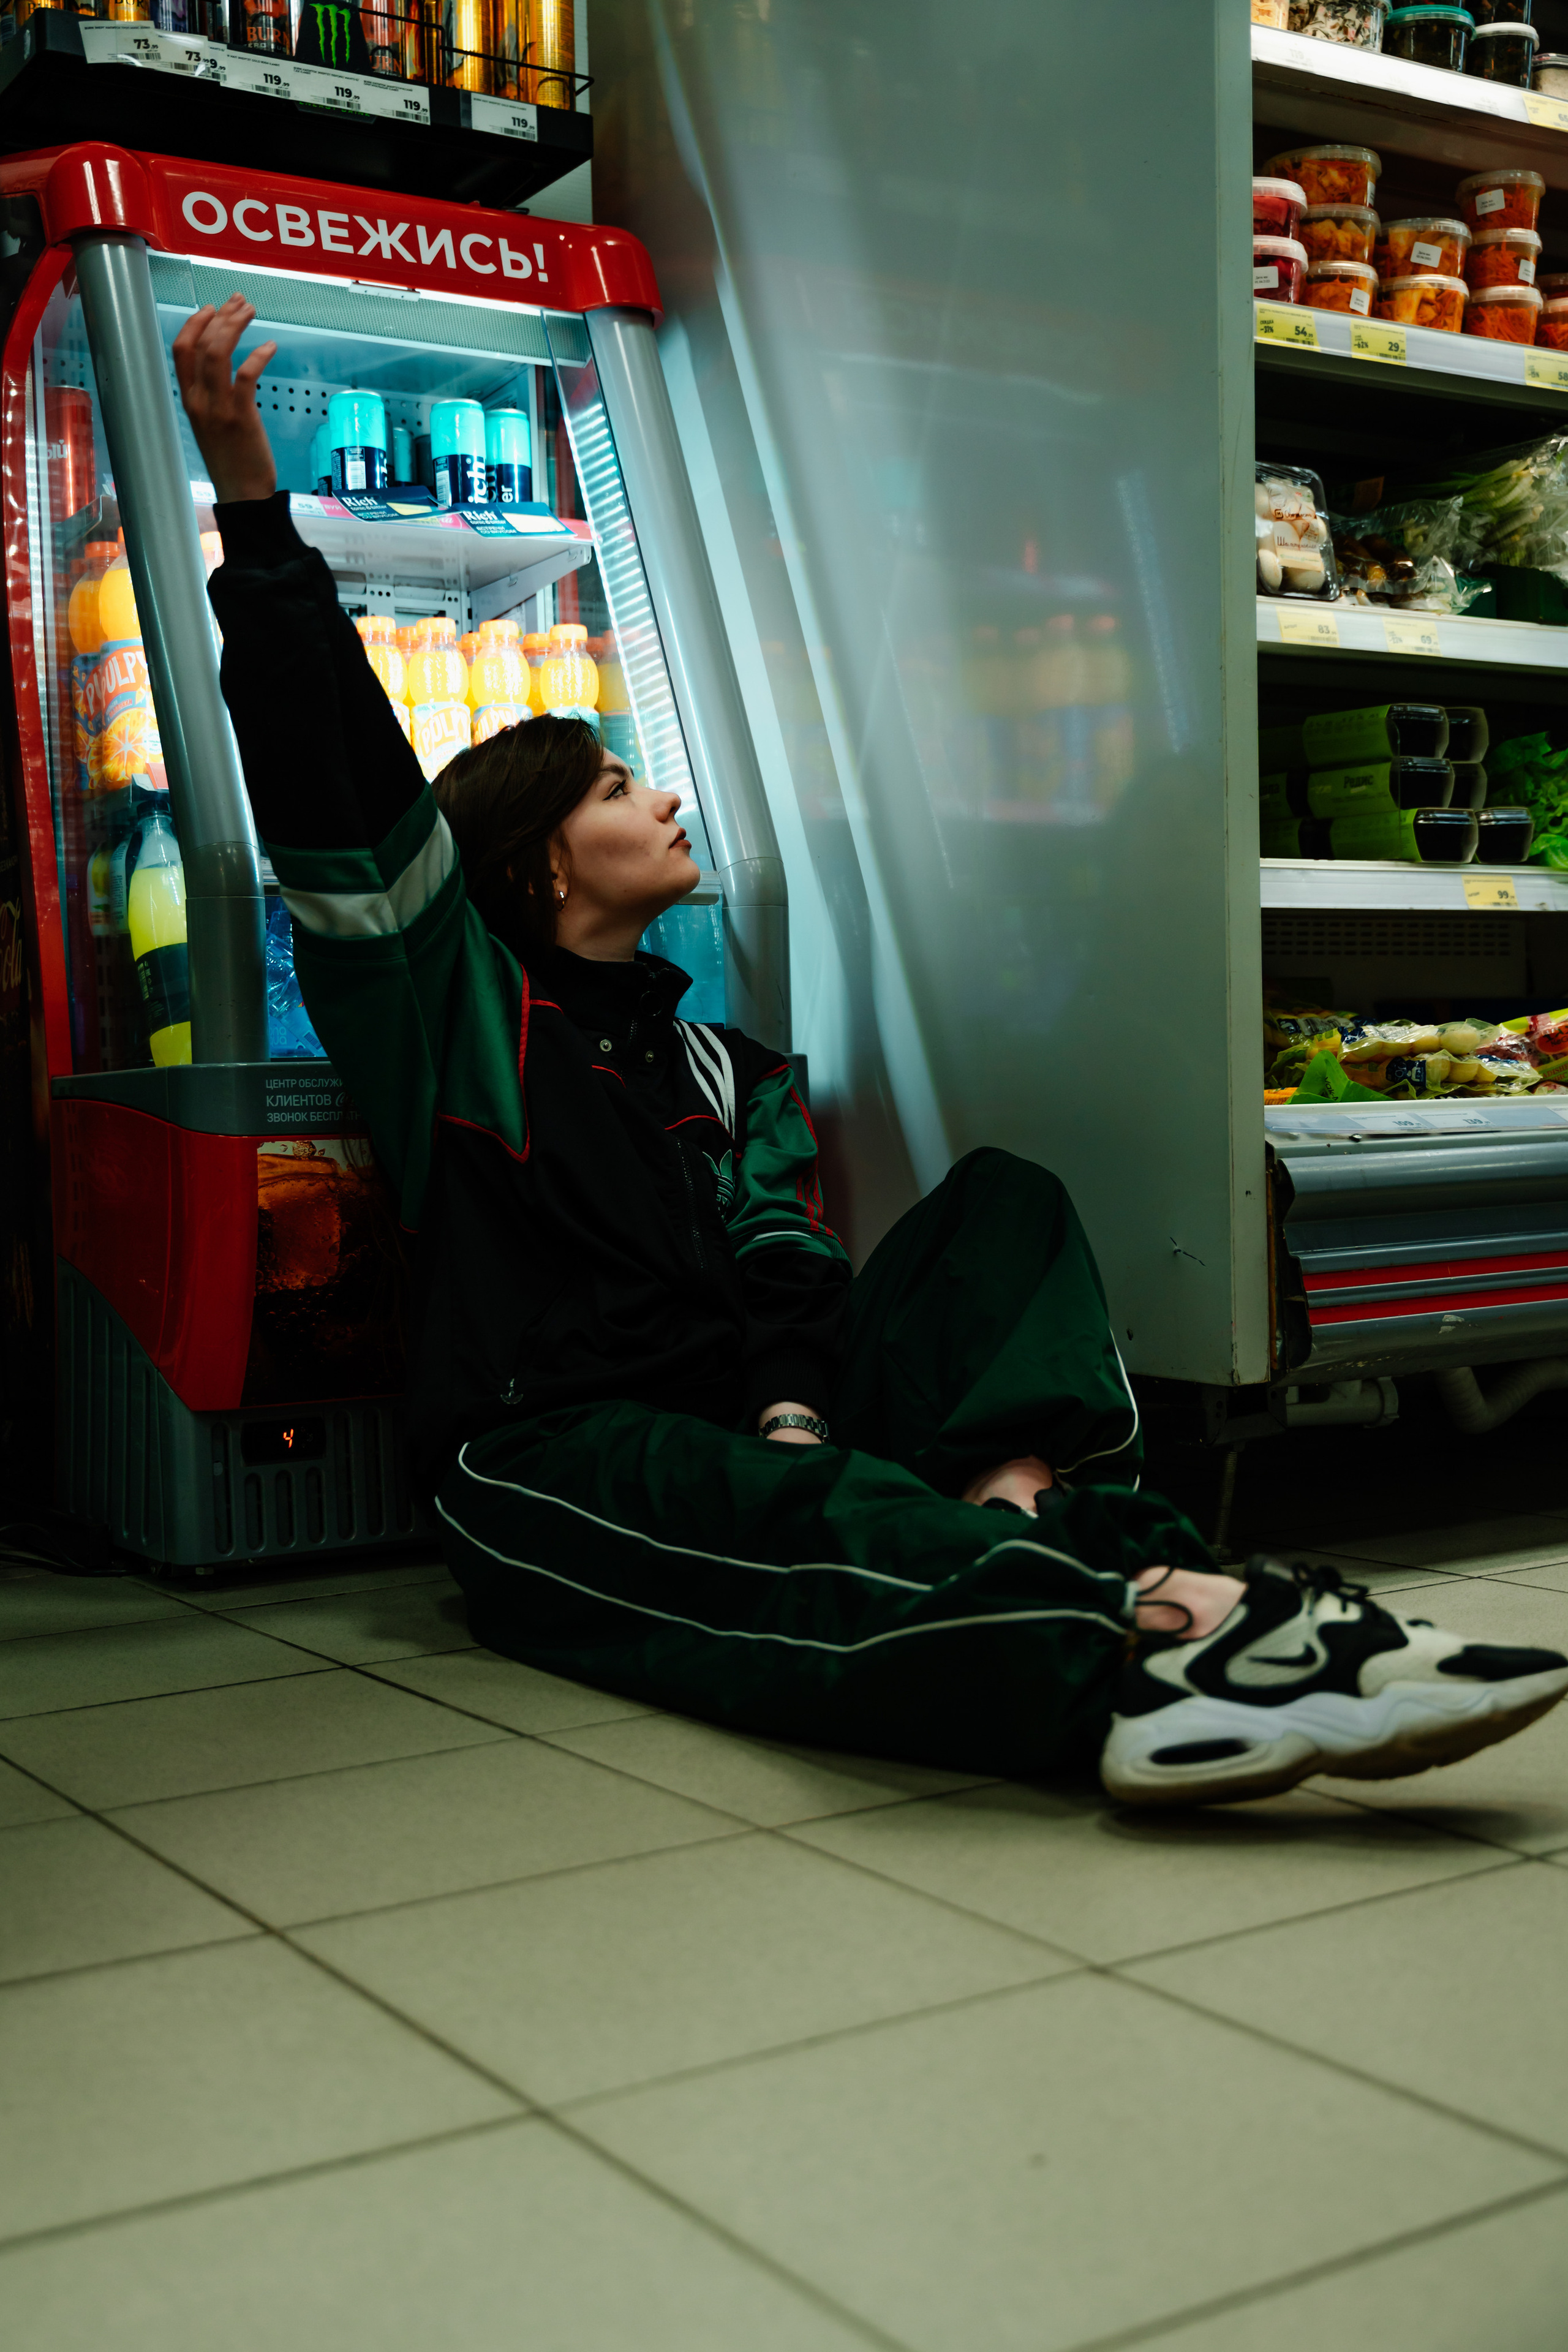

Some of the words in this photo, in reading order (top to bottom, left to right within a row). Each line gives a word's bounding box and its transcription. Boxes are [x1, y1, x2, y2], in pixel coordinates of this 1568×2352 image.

[246, 26, 290, 47] BURN
[182, 191, 549, 283] ОСВЕЖИСЬ!
[467, 458, 488, 504] ich
[341, 497, 377, 507] Rich
[462, 510, 498, 521] Rich
[1343, 775, 1374, 788] Редис
[266, 1079, 297, 1090] ЦЕНТР
[299, 1078, 344, 1088] ОБСЛУЖИ
[266, 1094, 331, 1107] КЛИЕНТОВ
[267, 1112, 307, 1123] ЗВОНОК
[283, 1426, 293, 1444] 4
